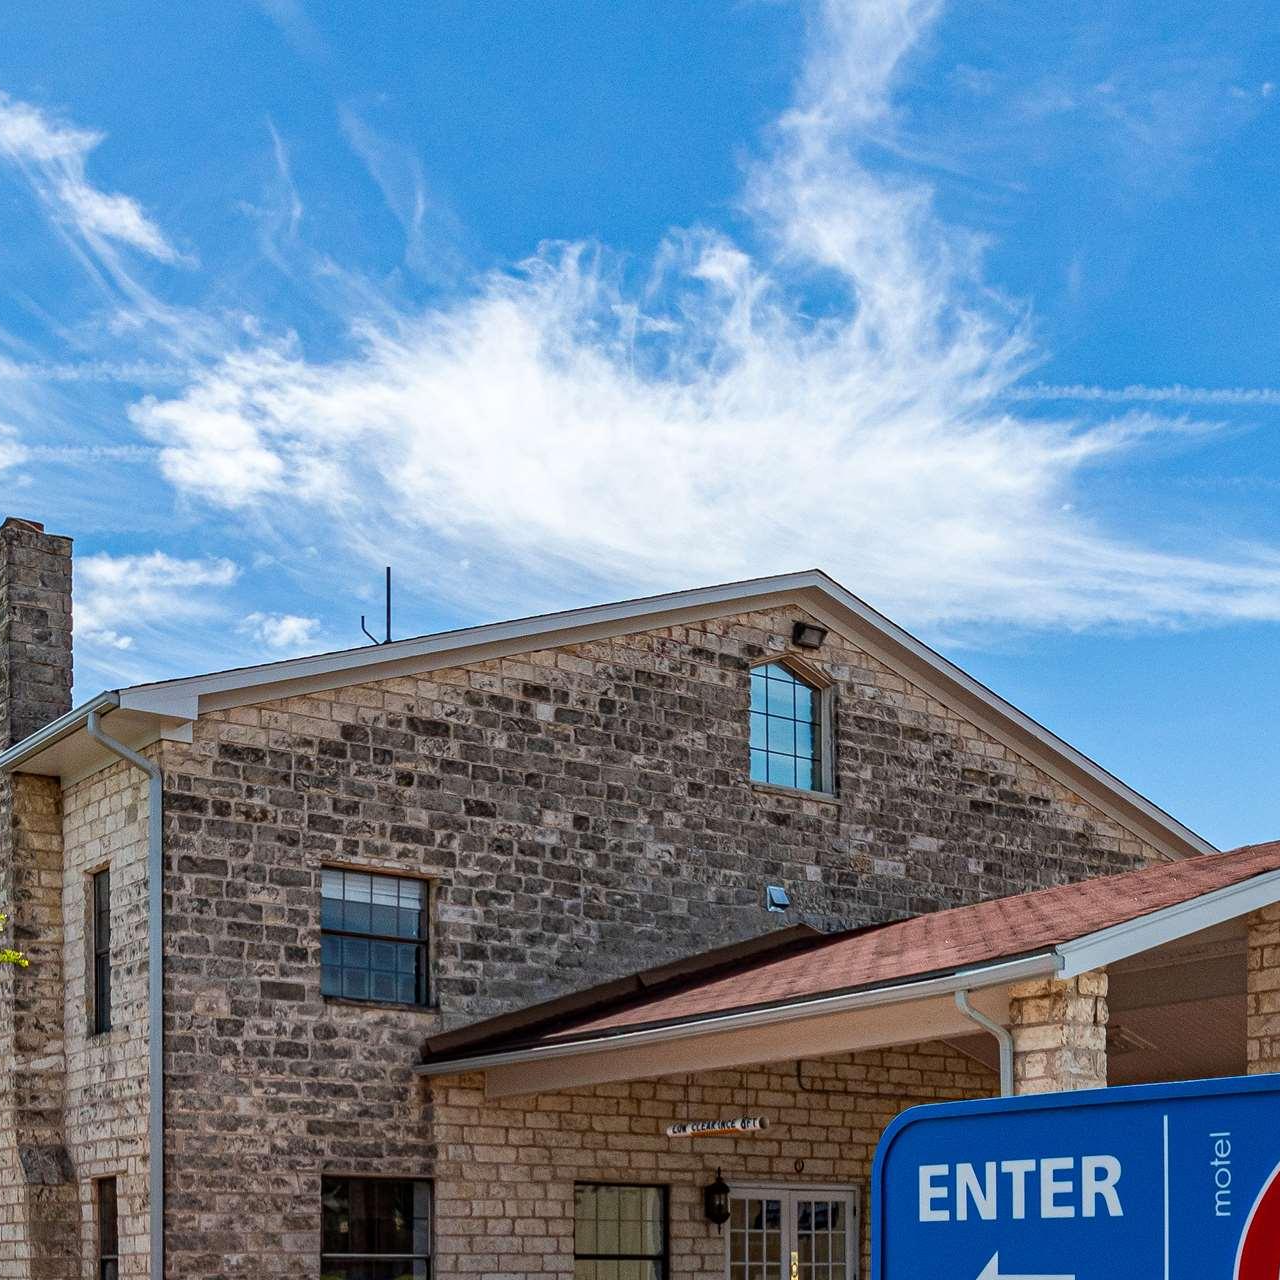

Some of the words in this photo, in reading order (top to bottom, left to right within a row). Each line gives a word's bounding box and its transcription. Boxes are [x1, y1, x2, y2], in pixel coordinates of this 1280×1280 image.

[672, 1123, 687, 1134] LOW
[918, 1154, 1124, 1222] ENTER
[1208, 1131, 1232, 1217] motel
